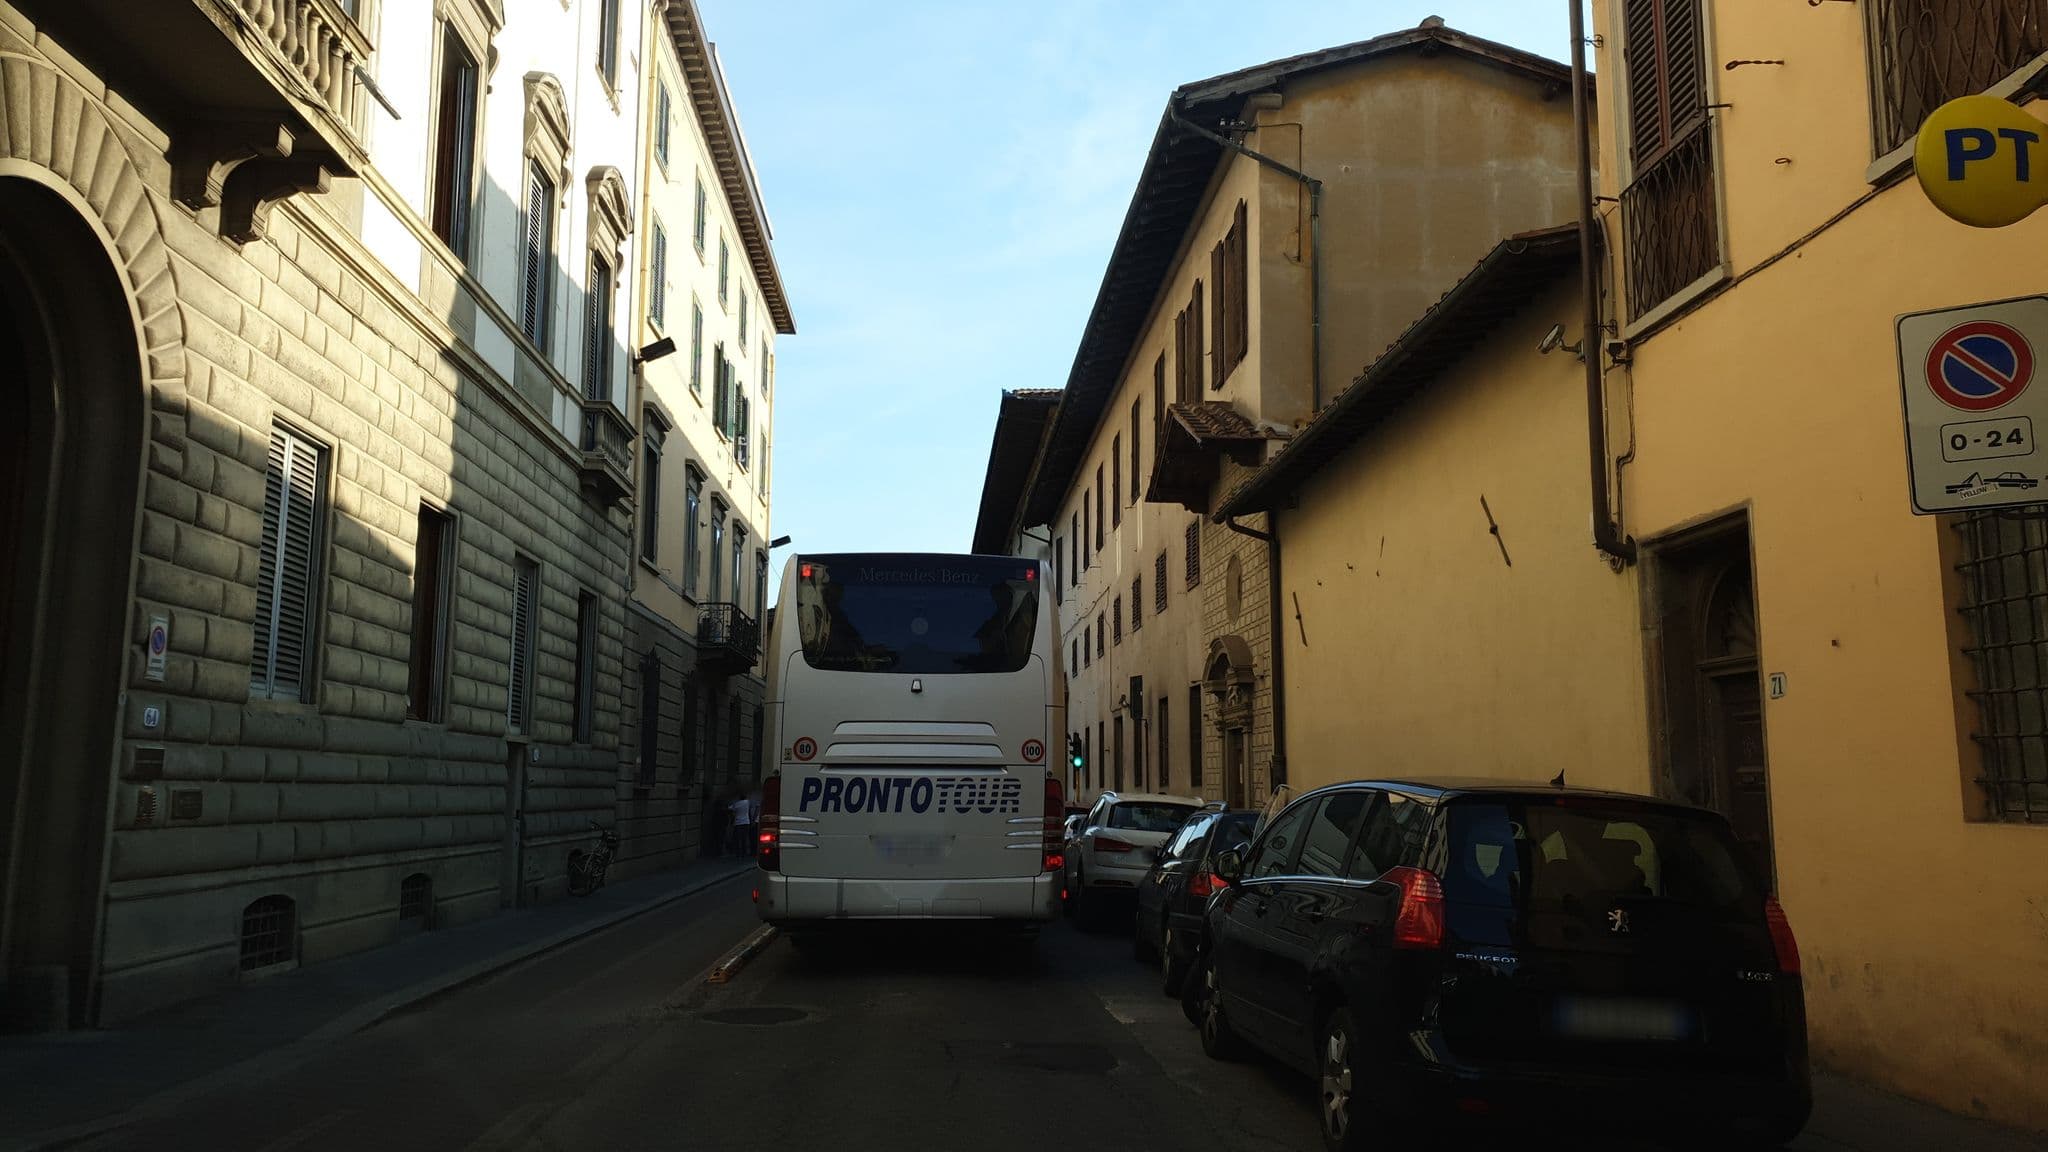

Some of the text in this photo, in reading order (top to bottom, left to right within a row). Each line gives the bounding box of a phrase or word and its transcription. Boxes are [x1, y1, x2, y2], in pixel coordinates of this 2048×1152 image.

[1944, 128, 2039, 182] PT
[1771, 676, 1784, 695] 71
[800, 744, 811, 754] 80
[1025, 746, 1041, 756] 100
[1455, 952, 1519, 964] PEUGEOT
